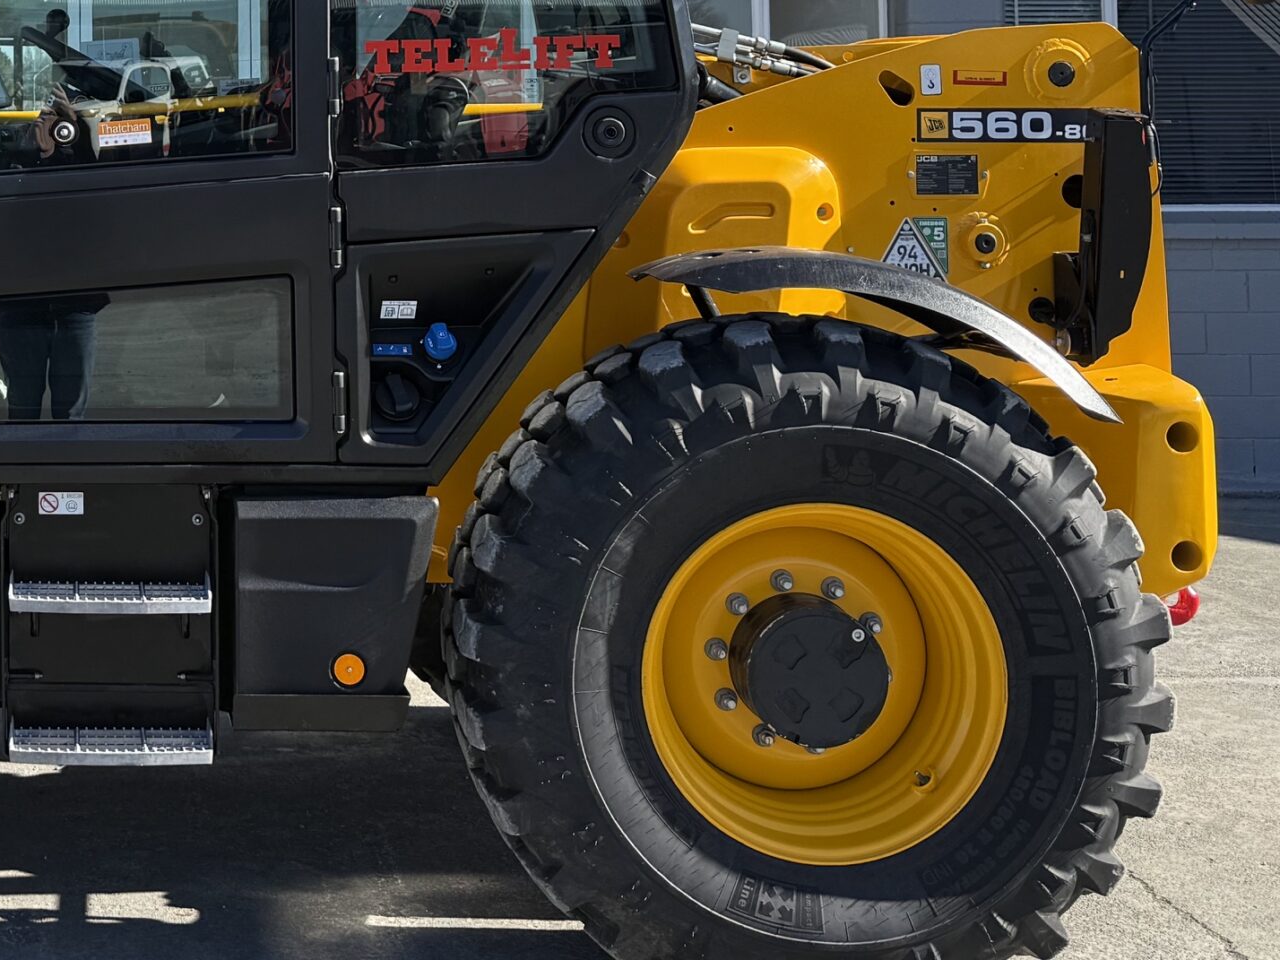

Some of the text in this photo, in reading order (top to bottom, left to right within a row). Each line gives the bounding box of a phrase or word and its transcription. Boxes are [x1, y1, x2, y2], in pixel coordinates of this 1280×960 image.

[365, 27, 620, 74] TELELIFT
[100, 122, 150, 135] Thatcham
[952, 111, 1087, 140] 560-8
[934, 227, 945, 240] 5
[897, 245, 918, 262] 94
[884, 451, 1070, 654] MICHELIN
[1028, 678, 1077, 811] BIBLOAD
